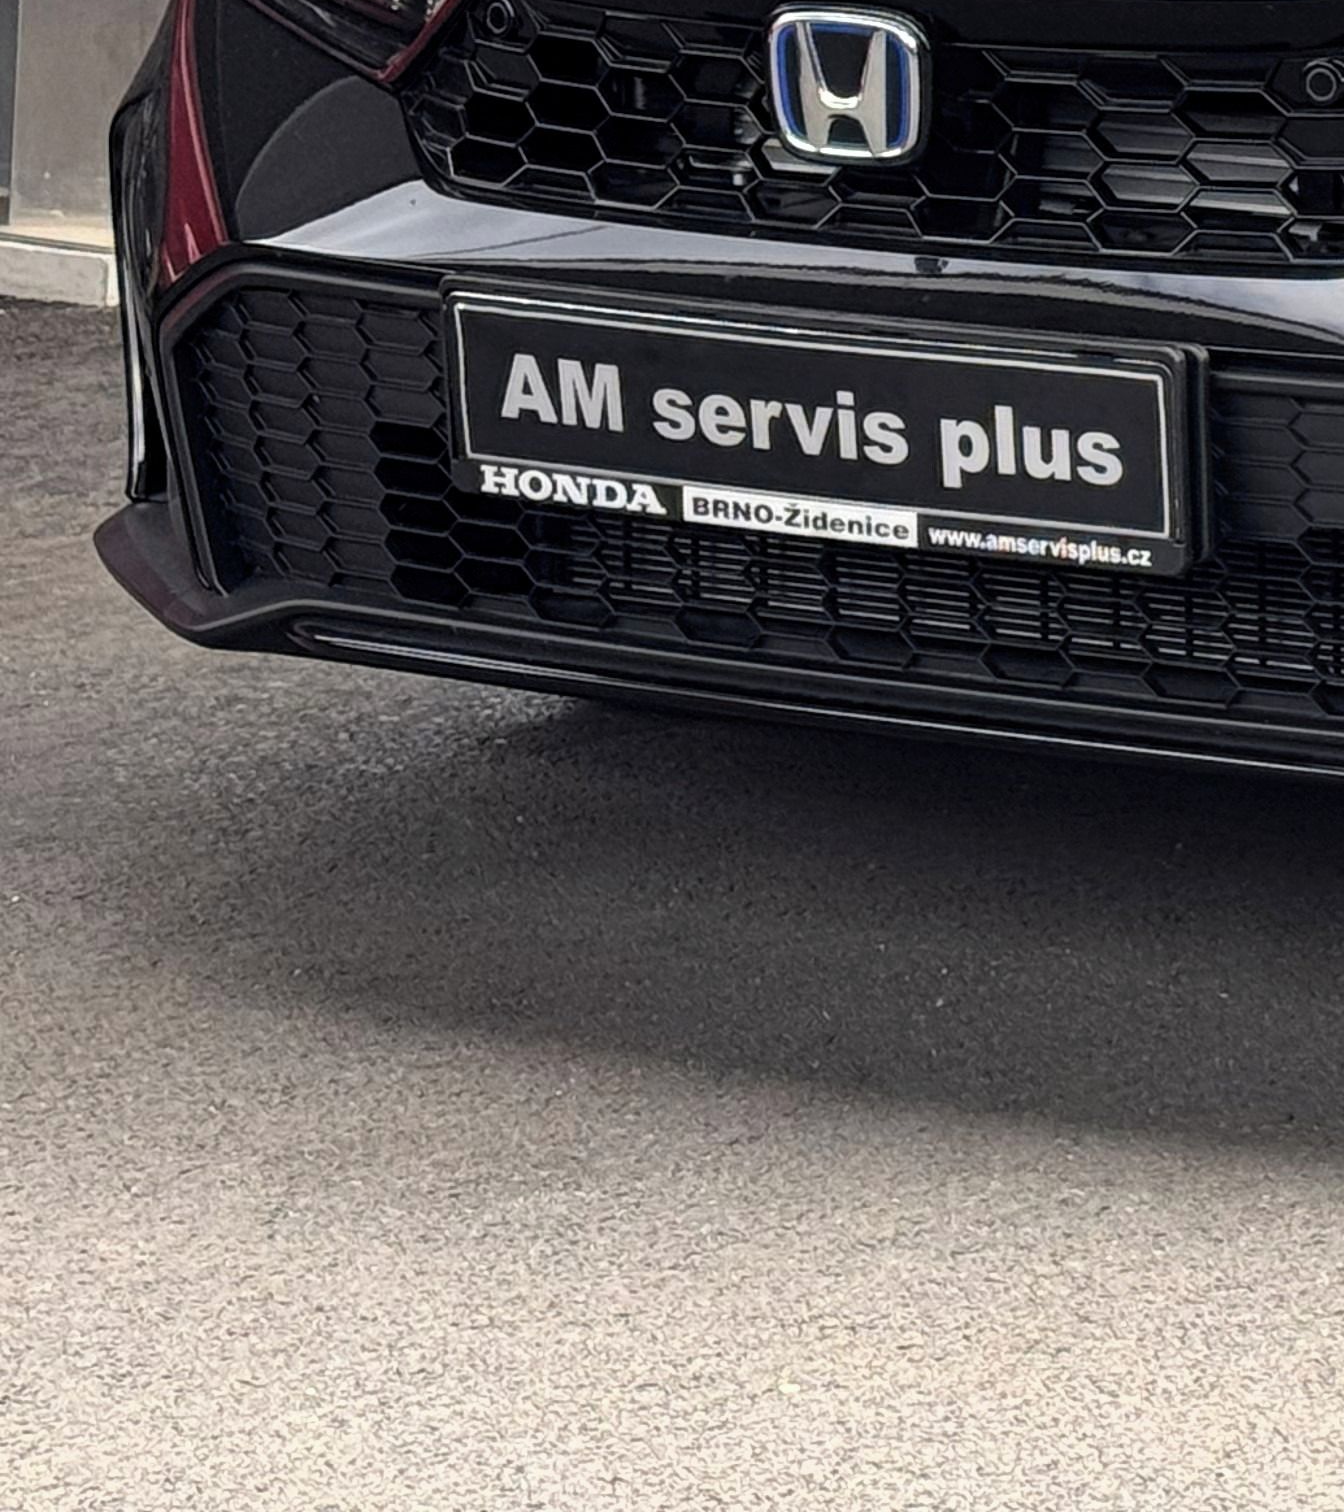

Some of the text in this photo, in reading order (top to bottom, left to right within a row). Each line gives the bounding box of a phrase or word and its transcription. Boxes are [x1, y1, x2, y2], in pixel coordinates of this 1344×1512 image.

[500, 353, 1123, 489] AM servis plus
[480, 464, 667, 515] HONDA
[692, 497, 910, 540] BRNO-Židenice
[928, 526, 1153, 567] www.amservisplus.cz
